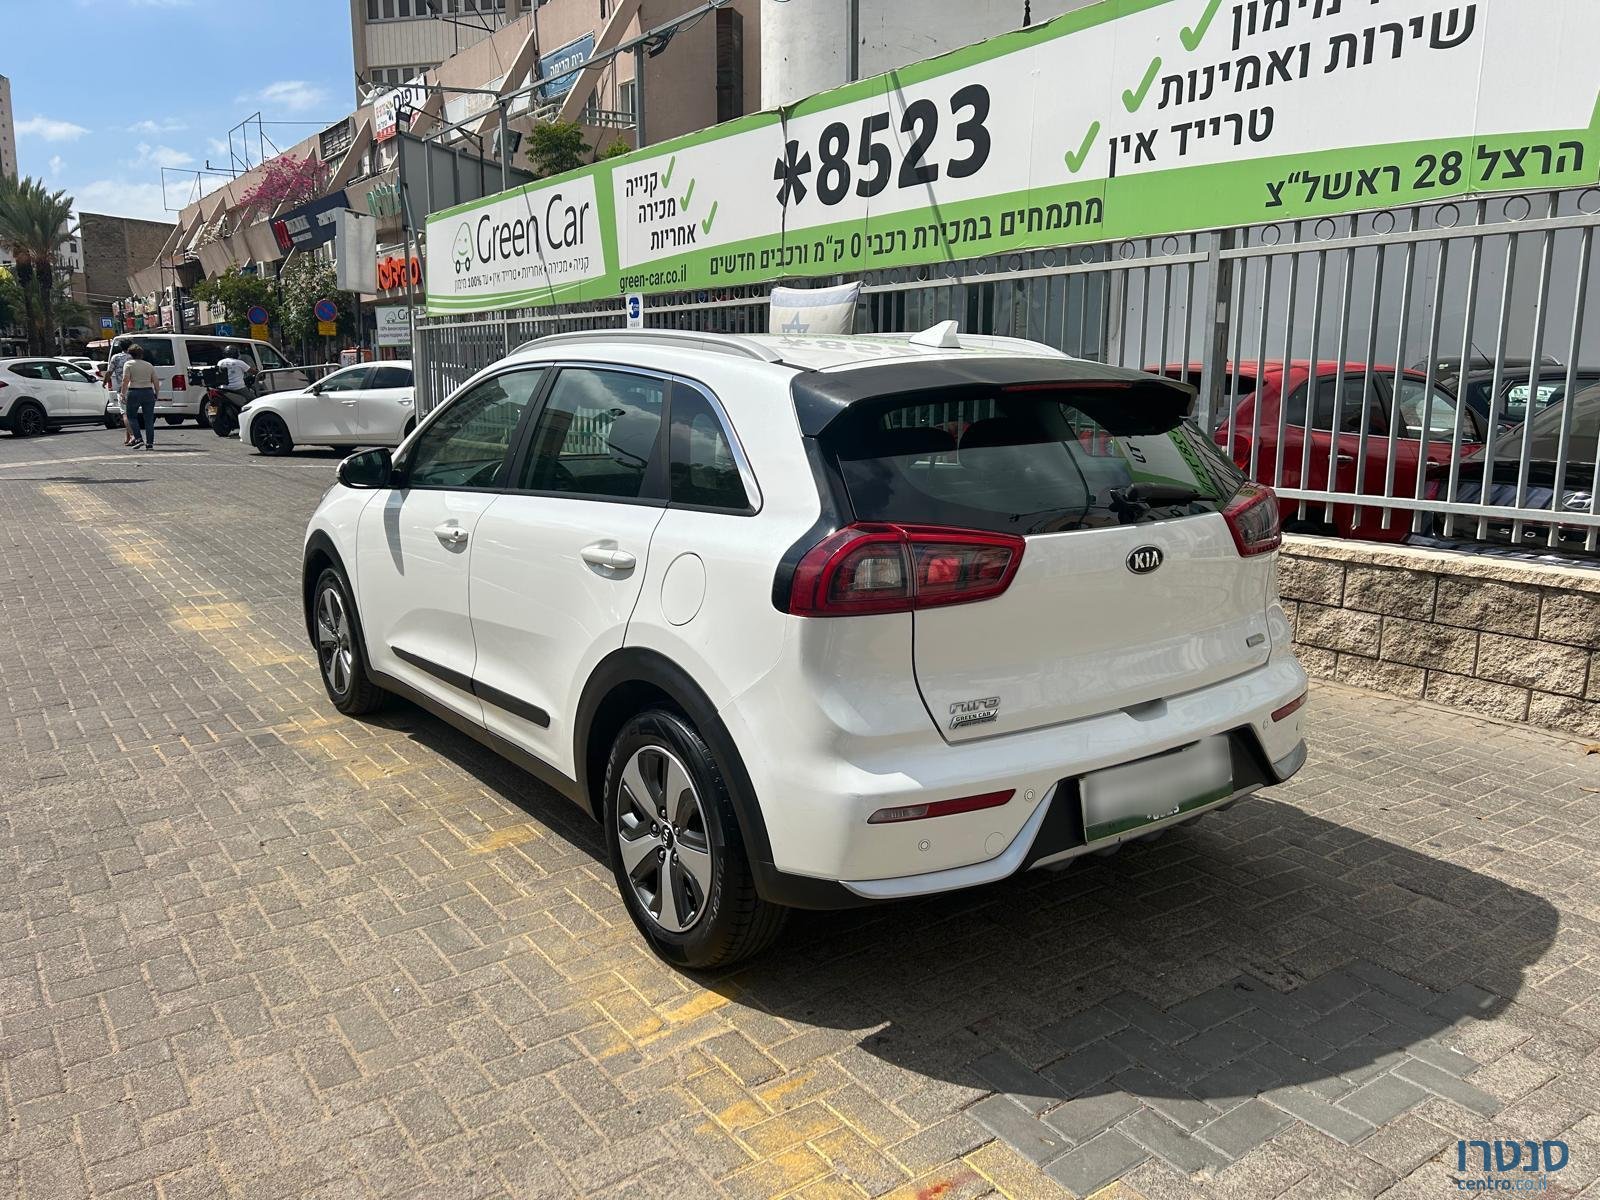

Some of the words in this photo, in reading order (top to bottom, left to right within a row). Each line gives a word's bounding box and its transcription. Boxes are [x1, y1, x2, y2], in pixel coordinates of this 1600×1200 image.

[1323, 3, 1477, 74] שירות
[1157, 42, 1310, 110] ואמינות
[1171, 105, 1275, 158] טרייד
[1107, 127, 1159, 178] אין
[1475, 139, 1585, 182] הרצל
[1411, 149, 1465, 191] 28
[625, 171, 658, 199] קנייה
[638, 197, 676, 224] מכירה
[1000, 196, 1104, 236] מתמחים
[476, 213, 541, 264] Green
[545, 193, 590, 250] Car
[650, 223, 697, 251] אחריות
[867, 228, 907, 256] רכבי
[913, 214, 992, 249] במכירת
[548, 260, 568, 275] מכירה
[573, 257, 589, 274] קניה
[709, 249, 756, 276] חדשים
[760, 242, 808, 270] ורכבים
[468, 276, 482, 288] 100%
[502, 269, 517, 282] טרייד
[521, 265, 543, 279] אחריות
[619, 264, 687, 294] green-car.co.il
[1133, 550, 1160, 569] KIA
[955, 714, 977, 722] GREEN
